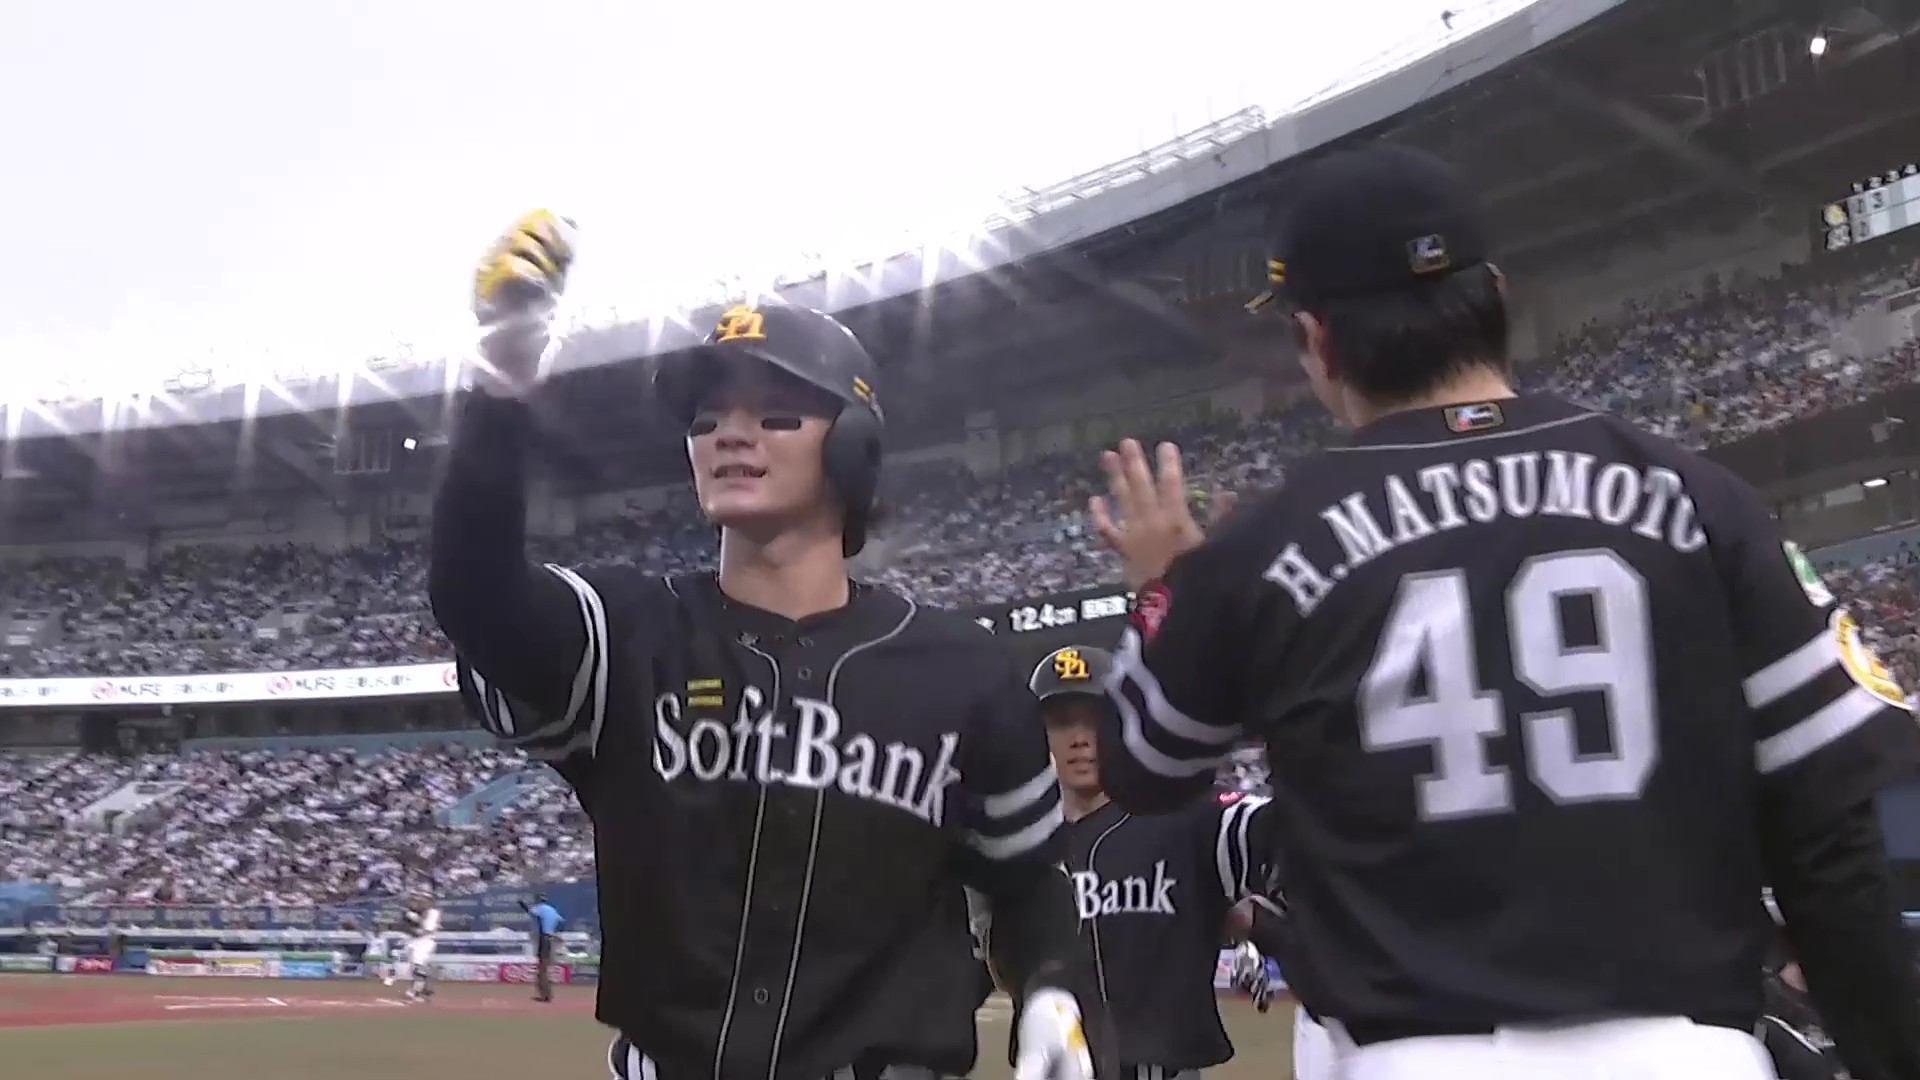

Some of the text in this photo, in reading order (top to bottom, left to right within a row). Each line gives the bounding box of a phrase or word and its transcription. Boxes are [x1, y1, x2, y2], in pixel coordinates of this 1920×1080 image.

[1355, 547, 1661, 822] 49
[653, 685, 963, 827] SoftBank
[1071, 859, 1178, 920] Bank
